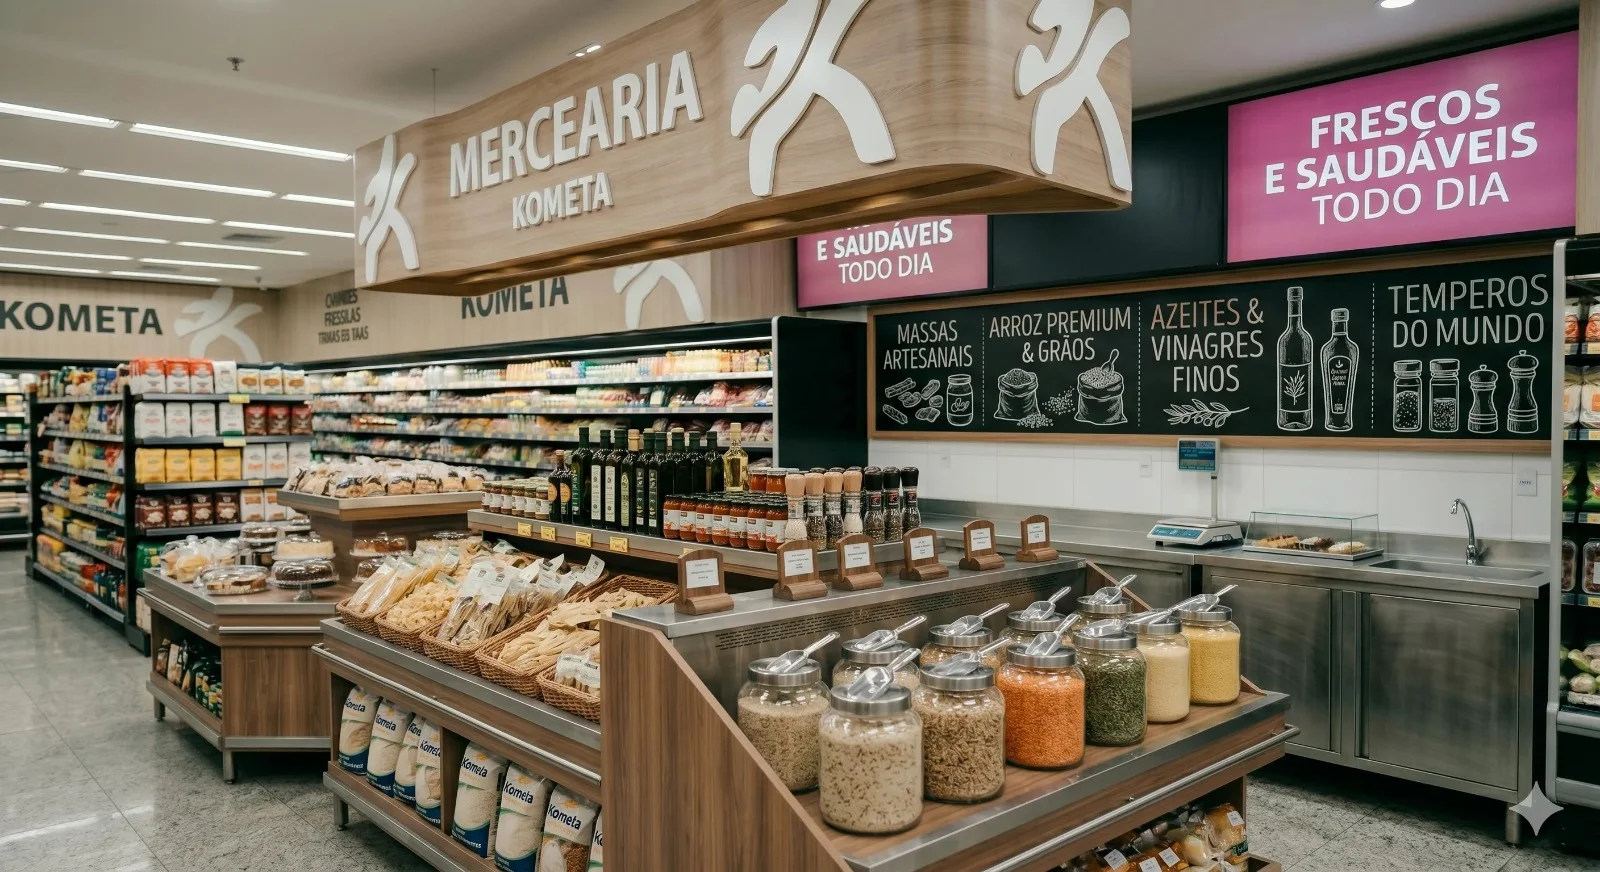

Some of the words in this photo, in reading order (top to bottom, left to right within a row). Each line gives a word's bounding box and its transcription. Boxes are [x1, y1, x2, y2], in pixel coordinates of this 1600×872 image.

[450, 50, 704, 198] MERCEARIA
[1311, 83, 1501, 149] FRESCOS
[1265, 162, 1285, 195] E
[1296, 121, 1538, 190] SAUDÁVEIS
[512, 171, 614, 230] KOMETA
[1311, 183, 1422, 226] TODO
[1436, 171, 1510, 211] DIA
[817, 239, 828, 261] E
[833, 219, 953, 259] SAUDÁVEIS
[838, 257, 892, 284] TODO
[898, 252, 934, 278] DIA
[1387, 273, 1549, 315] TEMPEROS
[0, 300, 163, 335] KOMETA
[989, 312, 1043, 339] ARROZ
[1046, 306, 1131, 335] PREMIUM
[1150, 298, 1241, 331] AZEITES
[1246, 297, 1265, 325] &
[1393, 319, 1428, 348] DO
[1436, 312, 1545, 347] MUNDO
[897, 319, 958, 345] MASSAS
[1022, 342, 1035, 363] &
[1038, 334, 1096, 362] GRÃOS
[1151, 329, 1264, 361] VINAGRES
[883, 344, 973, 370] ARTESANAIS
[1173, 364, 1240, 392] FINOS
[461, 756, 488, 778] Kometa
[504, 781, 534, 804] Kometa
[548, 804, 582, 830] Kometa
